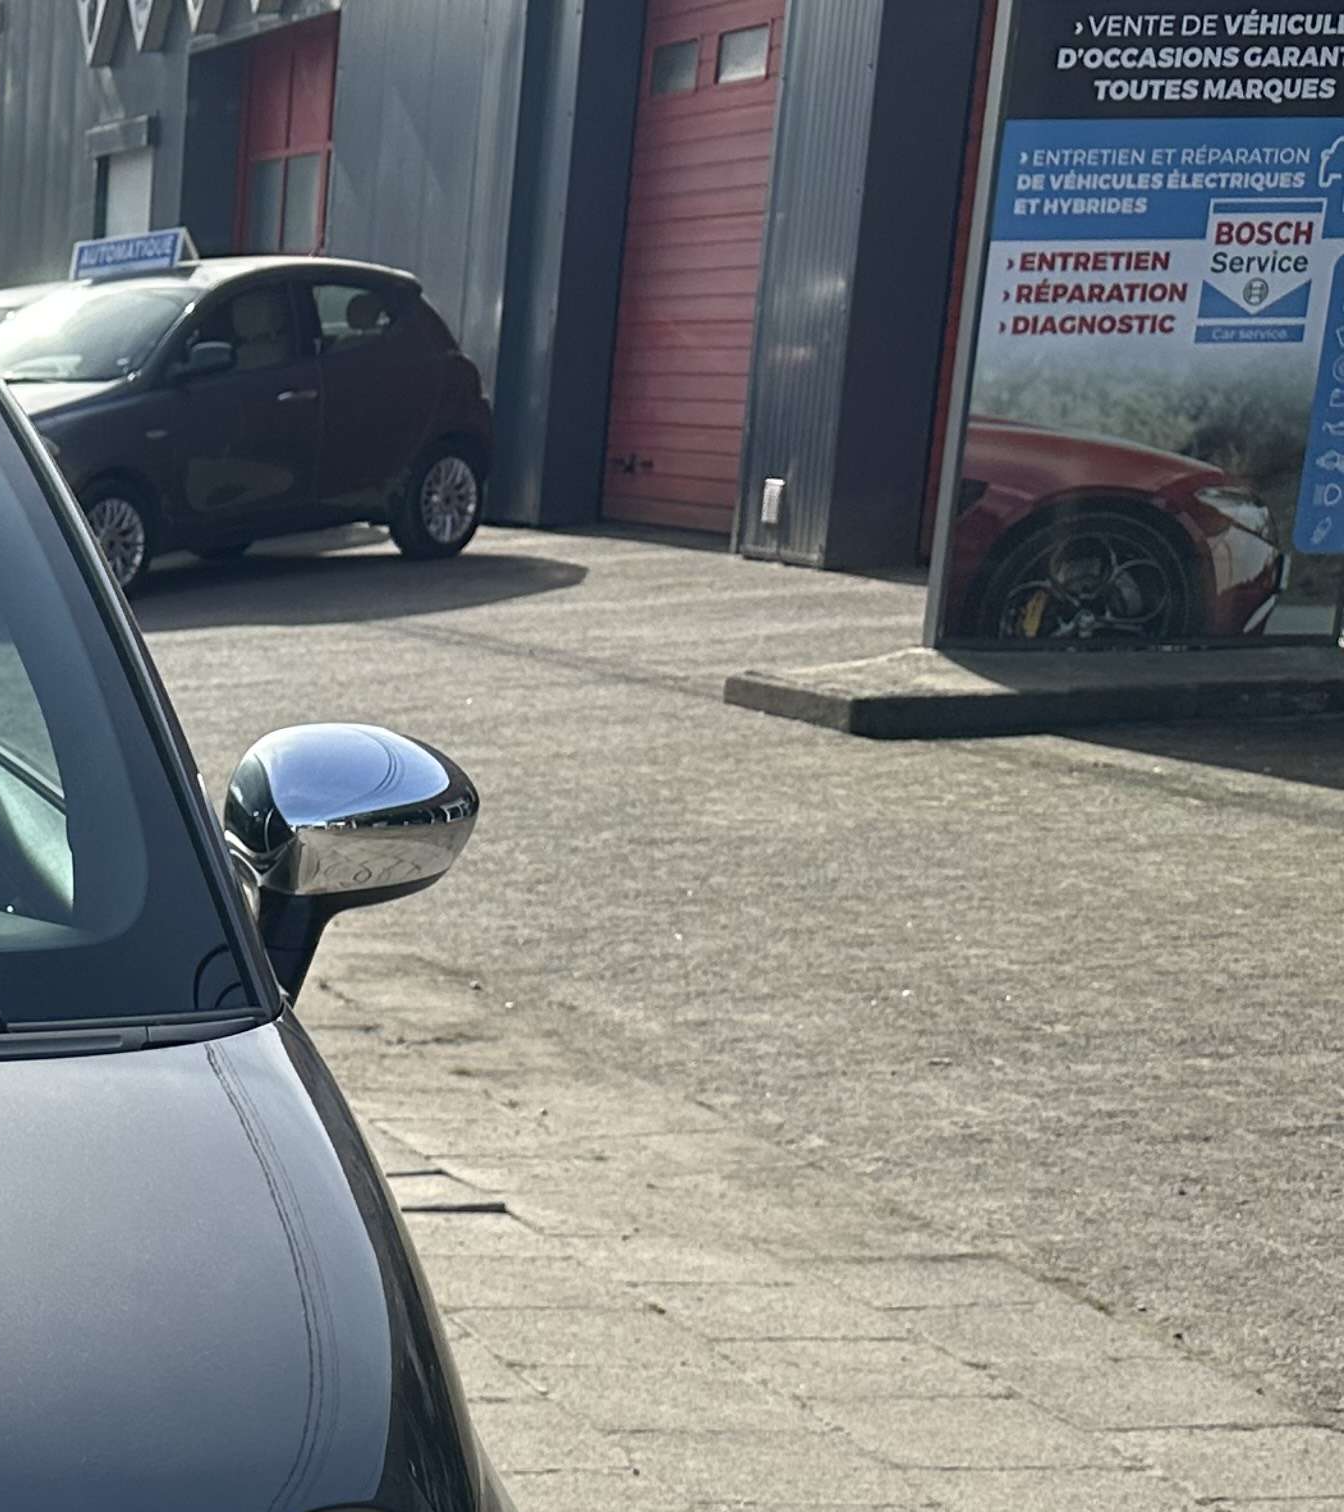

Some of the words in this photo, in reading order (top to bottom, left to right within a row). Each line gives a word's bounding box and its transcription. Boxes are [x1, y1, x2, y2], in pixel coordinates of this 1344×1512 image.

[1089, 15, 1177, 37] VENTE
[1181, 15, 1218, 36] DE
[1057, 47, 1238, 70] D'OCCASIONS
[1094, 79, 1198, 101] TOUTES
[1203, 78, 1336, 103] MARQUES
[1033, 148, 1145, 166] ENTRETIEN
[1151, 148, 1176, 165] ET
[1181, 143, 1311, 165] RÉPARATION
[1016, 174, 1044, 190] DE
[1049, 169, 1163, 190] VÉHICULES
[1166, 167, 1306, 191] ÉLECTRIQUES
[1014, 199, 1039, 215] ET
[1043, 198, 1147, 215] HYBRIDES
[1214, 221, 1314, 246] BOSCH
[1019, 251, 1170, 272] ENTRETIEN
[1211, 251, 1308, 274] Service
[1015, 279, 1188, 304] RÉPARATION
[1011, 314, 1176, 336] DIAGNOSTIC
